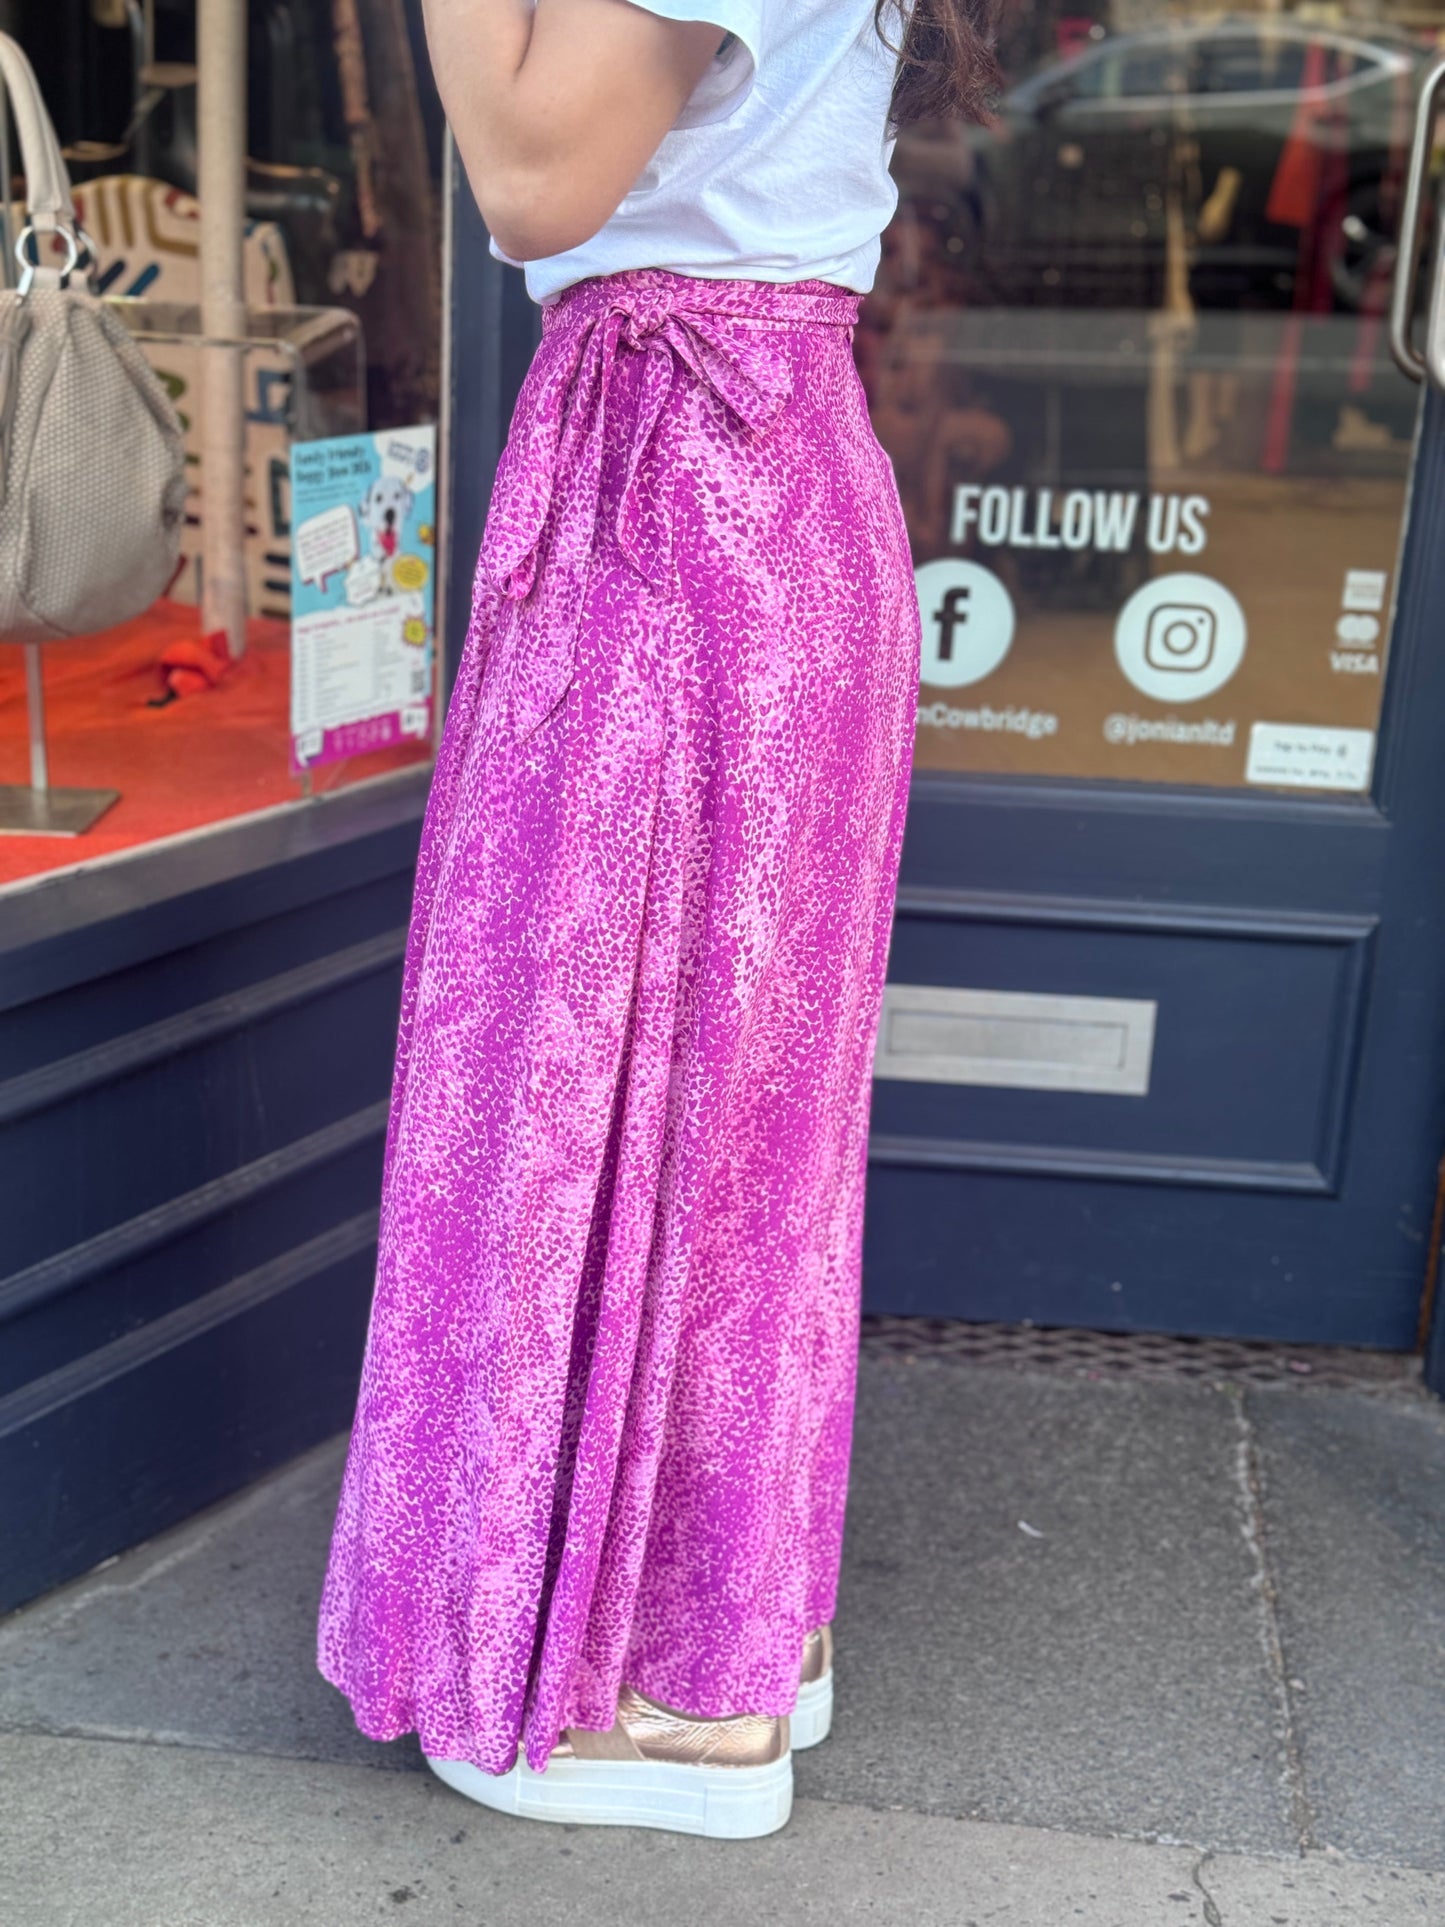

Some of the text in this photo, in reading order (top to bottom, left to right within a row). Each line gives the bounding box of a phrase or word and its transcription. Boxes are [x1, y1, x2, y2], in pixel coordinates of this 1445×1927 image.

[952, 484, 1210, 554] FOLLOW US
[1329, 650, 1379, 673] VISA
[916, 702, 1058, 739] nCowbridge
